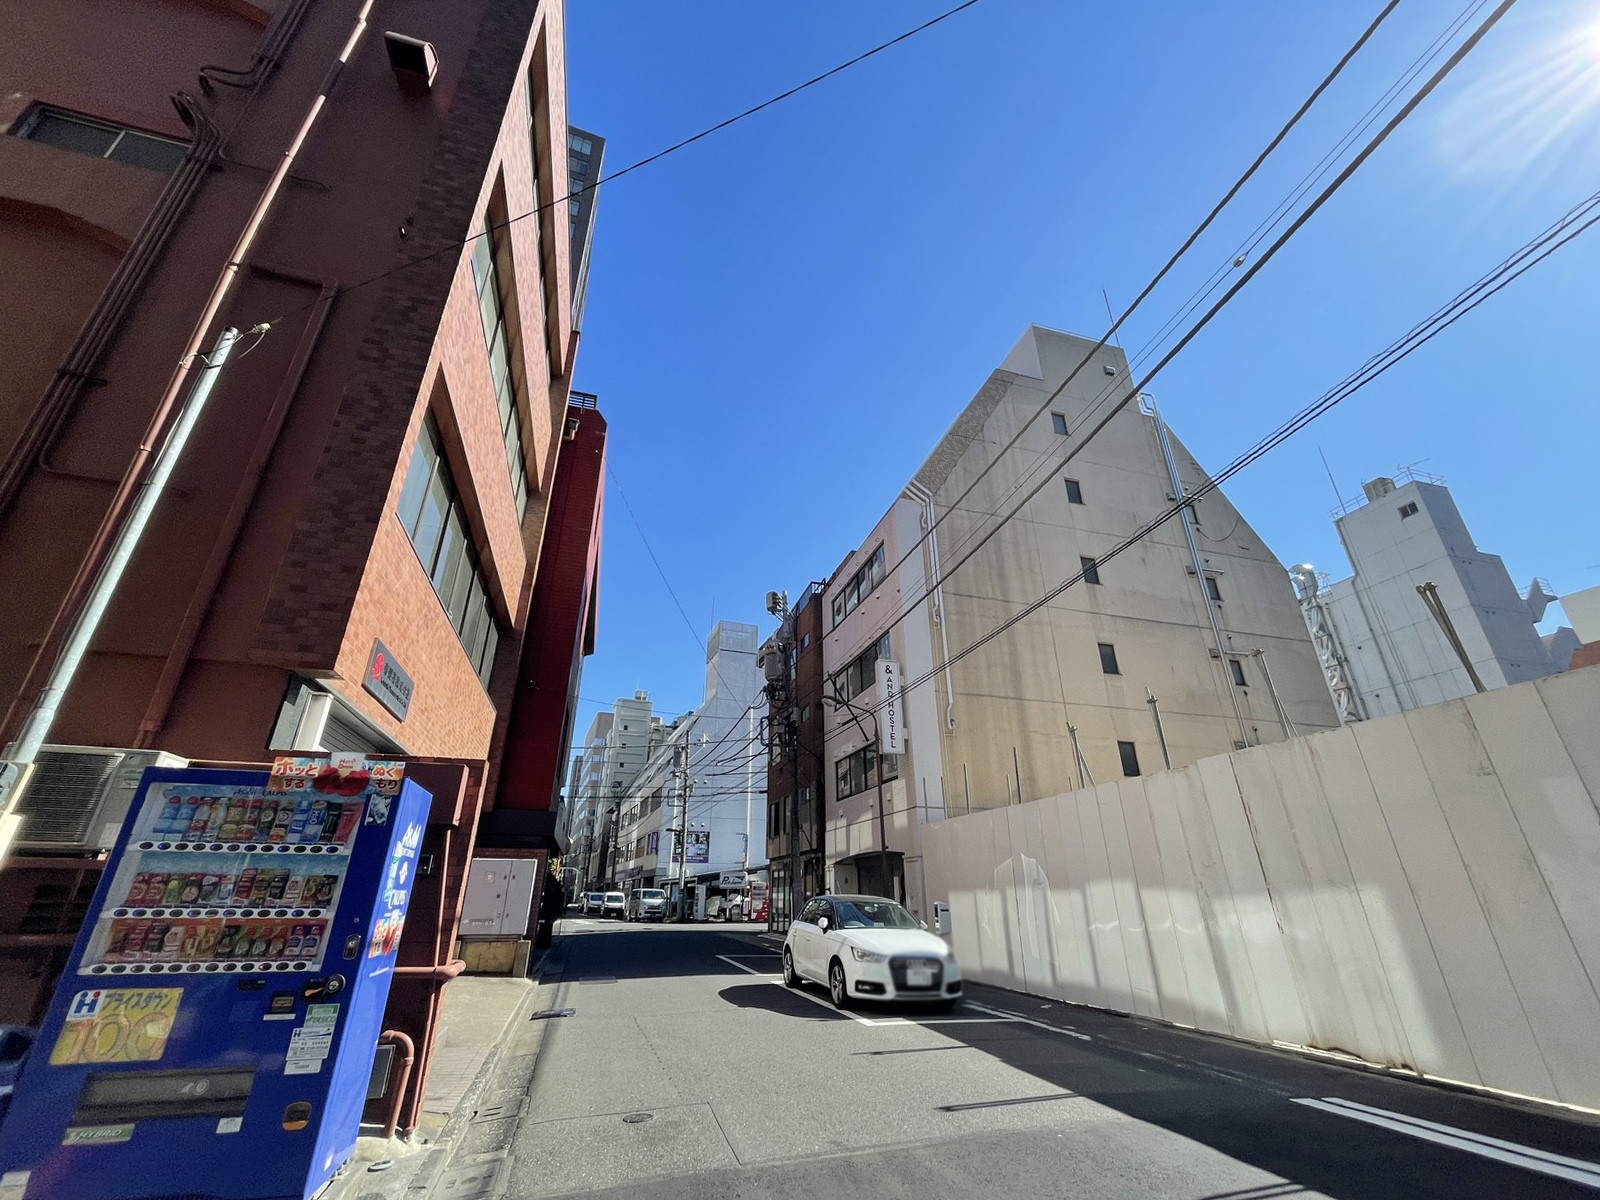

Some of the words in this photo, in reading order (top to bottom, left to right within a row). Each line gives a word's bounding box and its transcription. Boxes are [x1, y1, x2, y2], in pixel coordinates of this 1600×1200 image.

[888, 702, 896, 748] HOSTEL
[276, 759, 318, 777] ホッと
[372, 765, 395, 778] ぬく
[283, 777, 305, 788] する
[375, 779, 397, 789] もり
